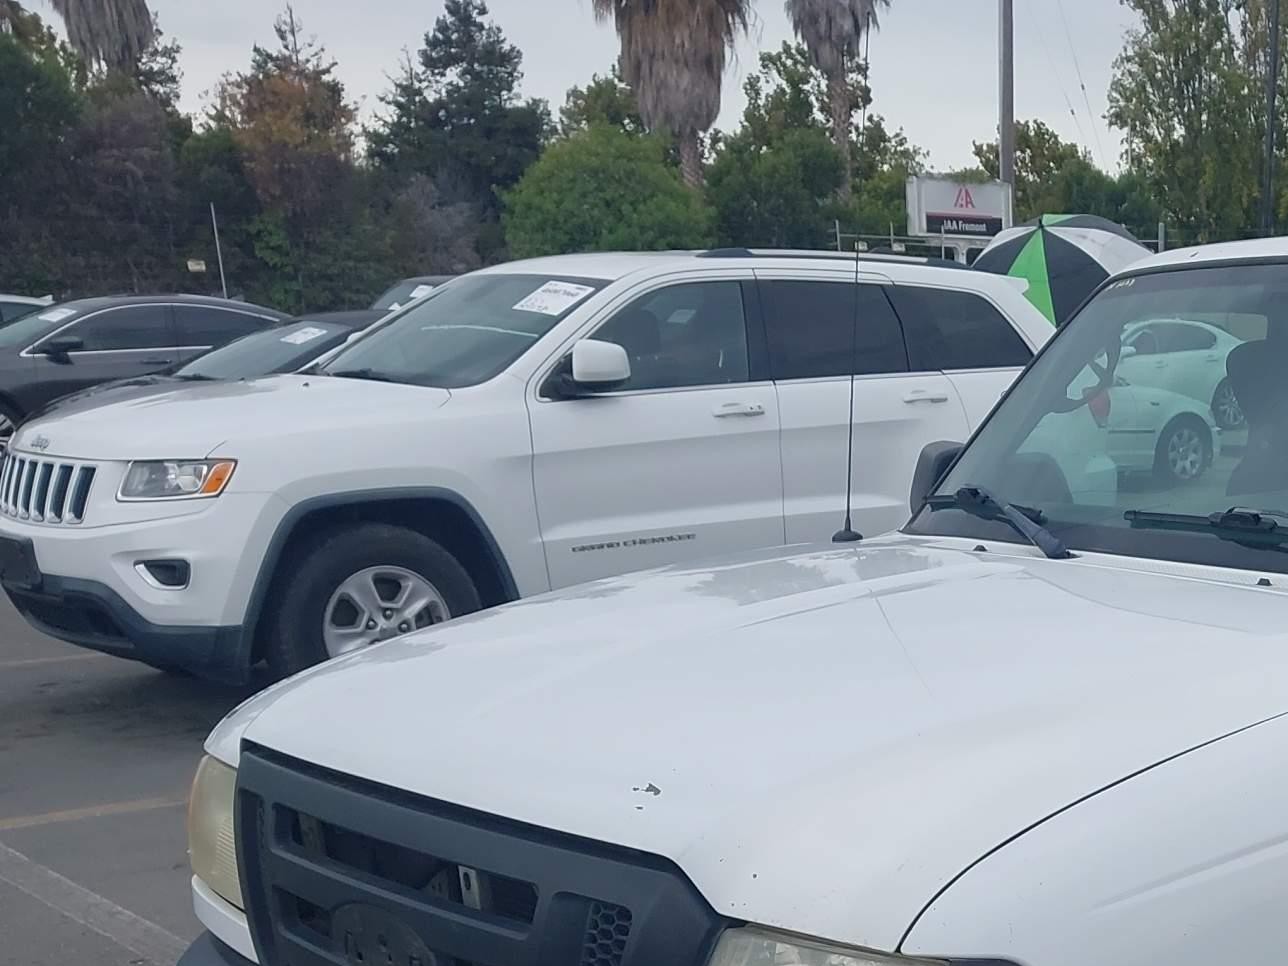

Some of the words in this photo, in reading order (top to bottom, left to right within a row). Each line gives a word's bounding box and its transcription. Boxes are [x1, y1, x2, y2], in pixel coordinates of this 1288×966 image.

[944, 219, 957, 230] IAA
[958, 220, 986, 232] Fremont
[571, 541, 620, 553] GRAND
[623, 533, 697, 548] CHEROKEE
